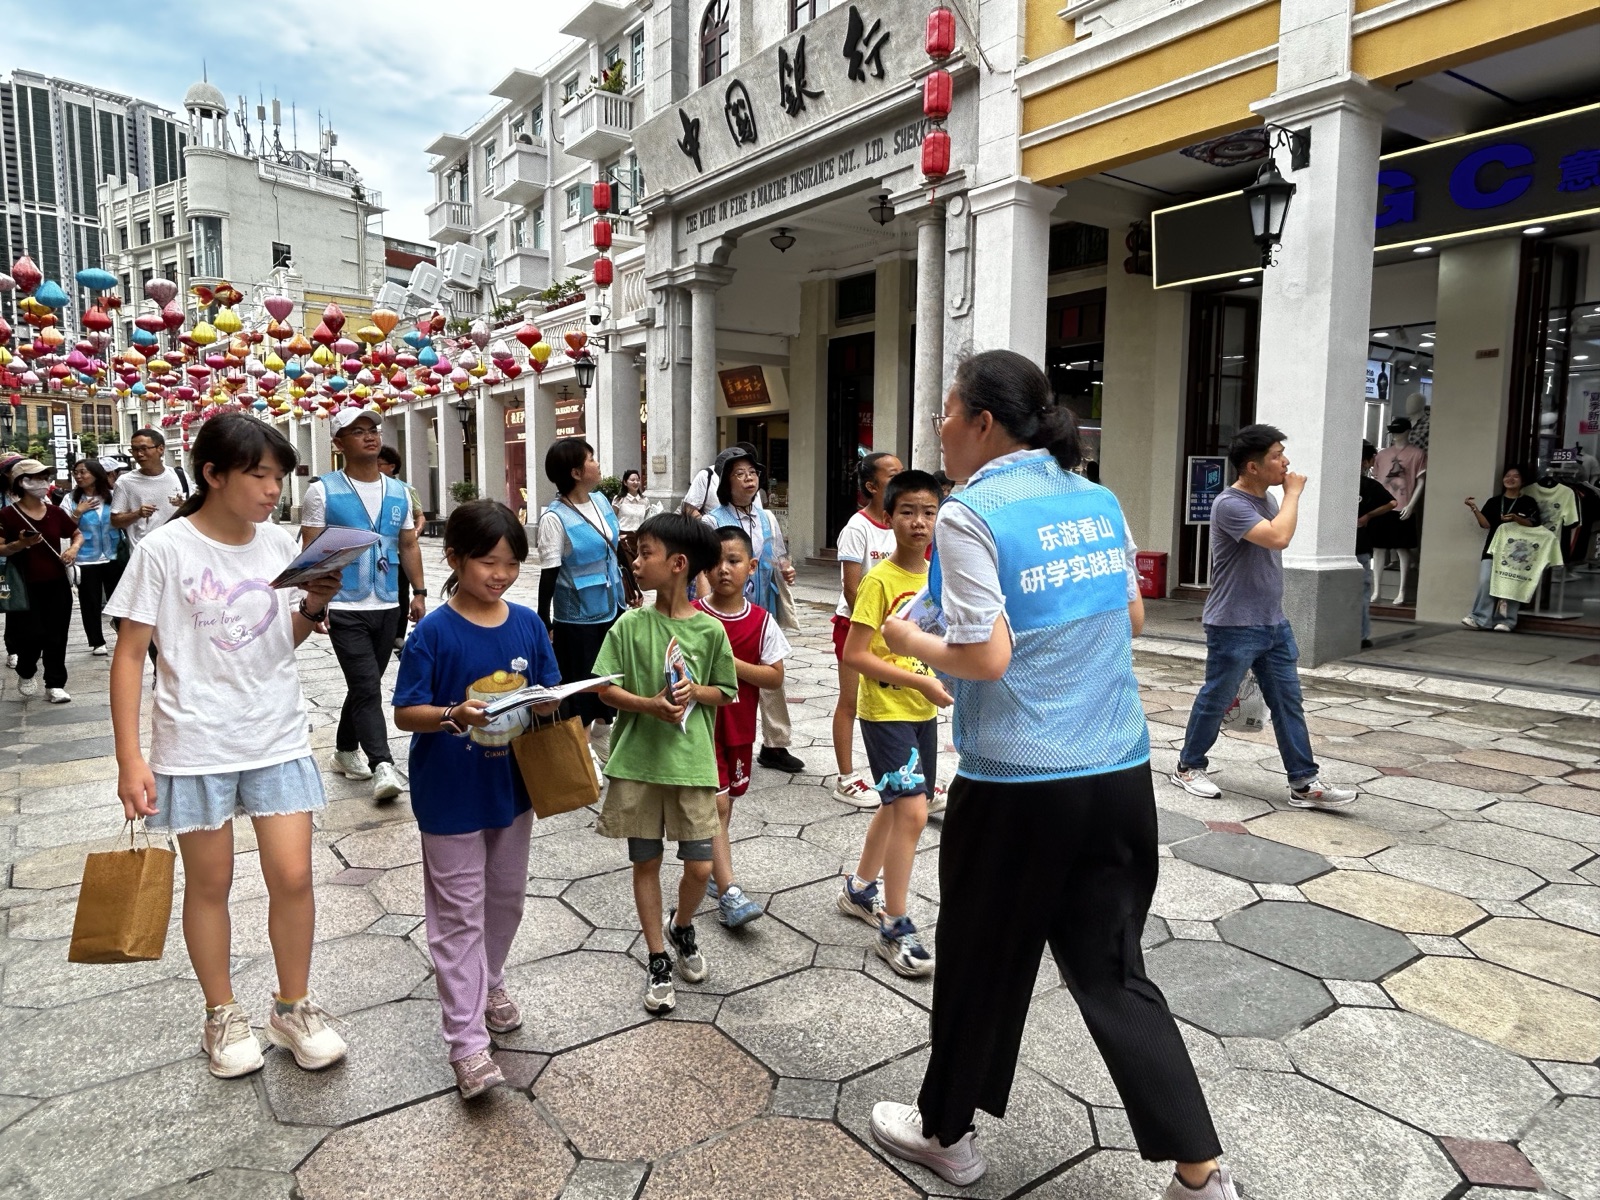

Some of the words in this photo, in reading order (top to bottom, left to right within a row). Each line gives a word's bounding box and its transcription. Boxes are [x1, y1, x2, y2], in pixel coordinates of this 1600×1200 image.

[686, 214, 698, 234] THE
[719, 200, 728, 221] ON
[730, 193, 748, 218] FIRE
[751, 190, 756, 209] &
[757, 177, 787, 208] MARINE
[790, 157, 835, 195] INSURANCE
[1561, 451, 1572, 460] 59
[1037, 514, 1115, 551] 乐游香山
[1020, 546, 1127, 594] 研学实践基
[191, 611, 217, 629] True
[220, 610, 242, 625] love
